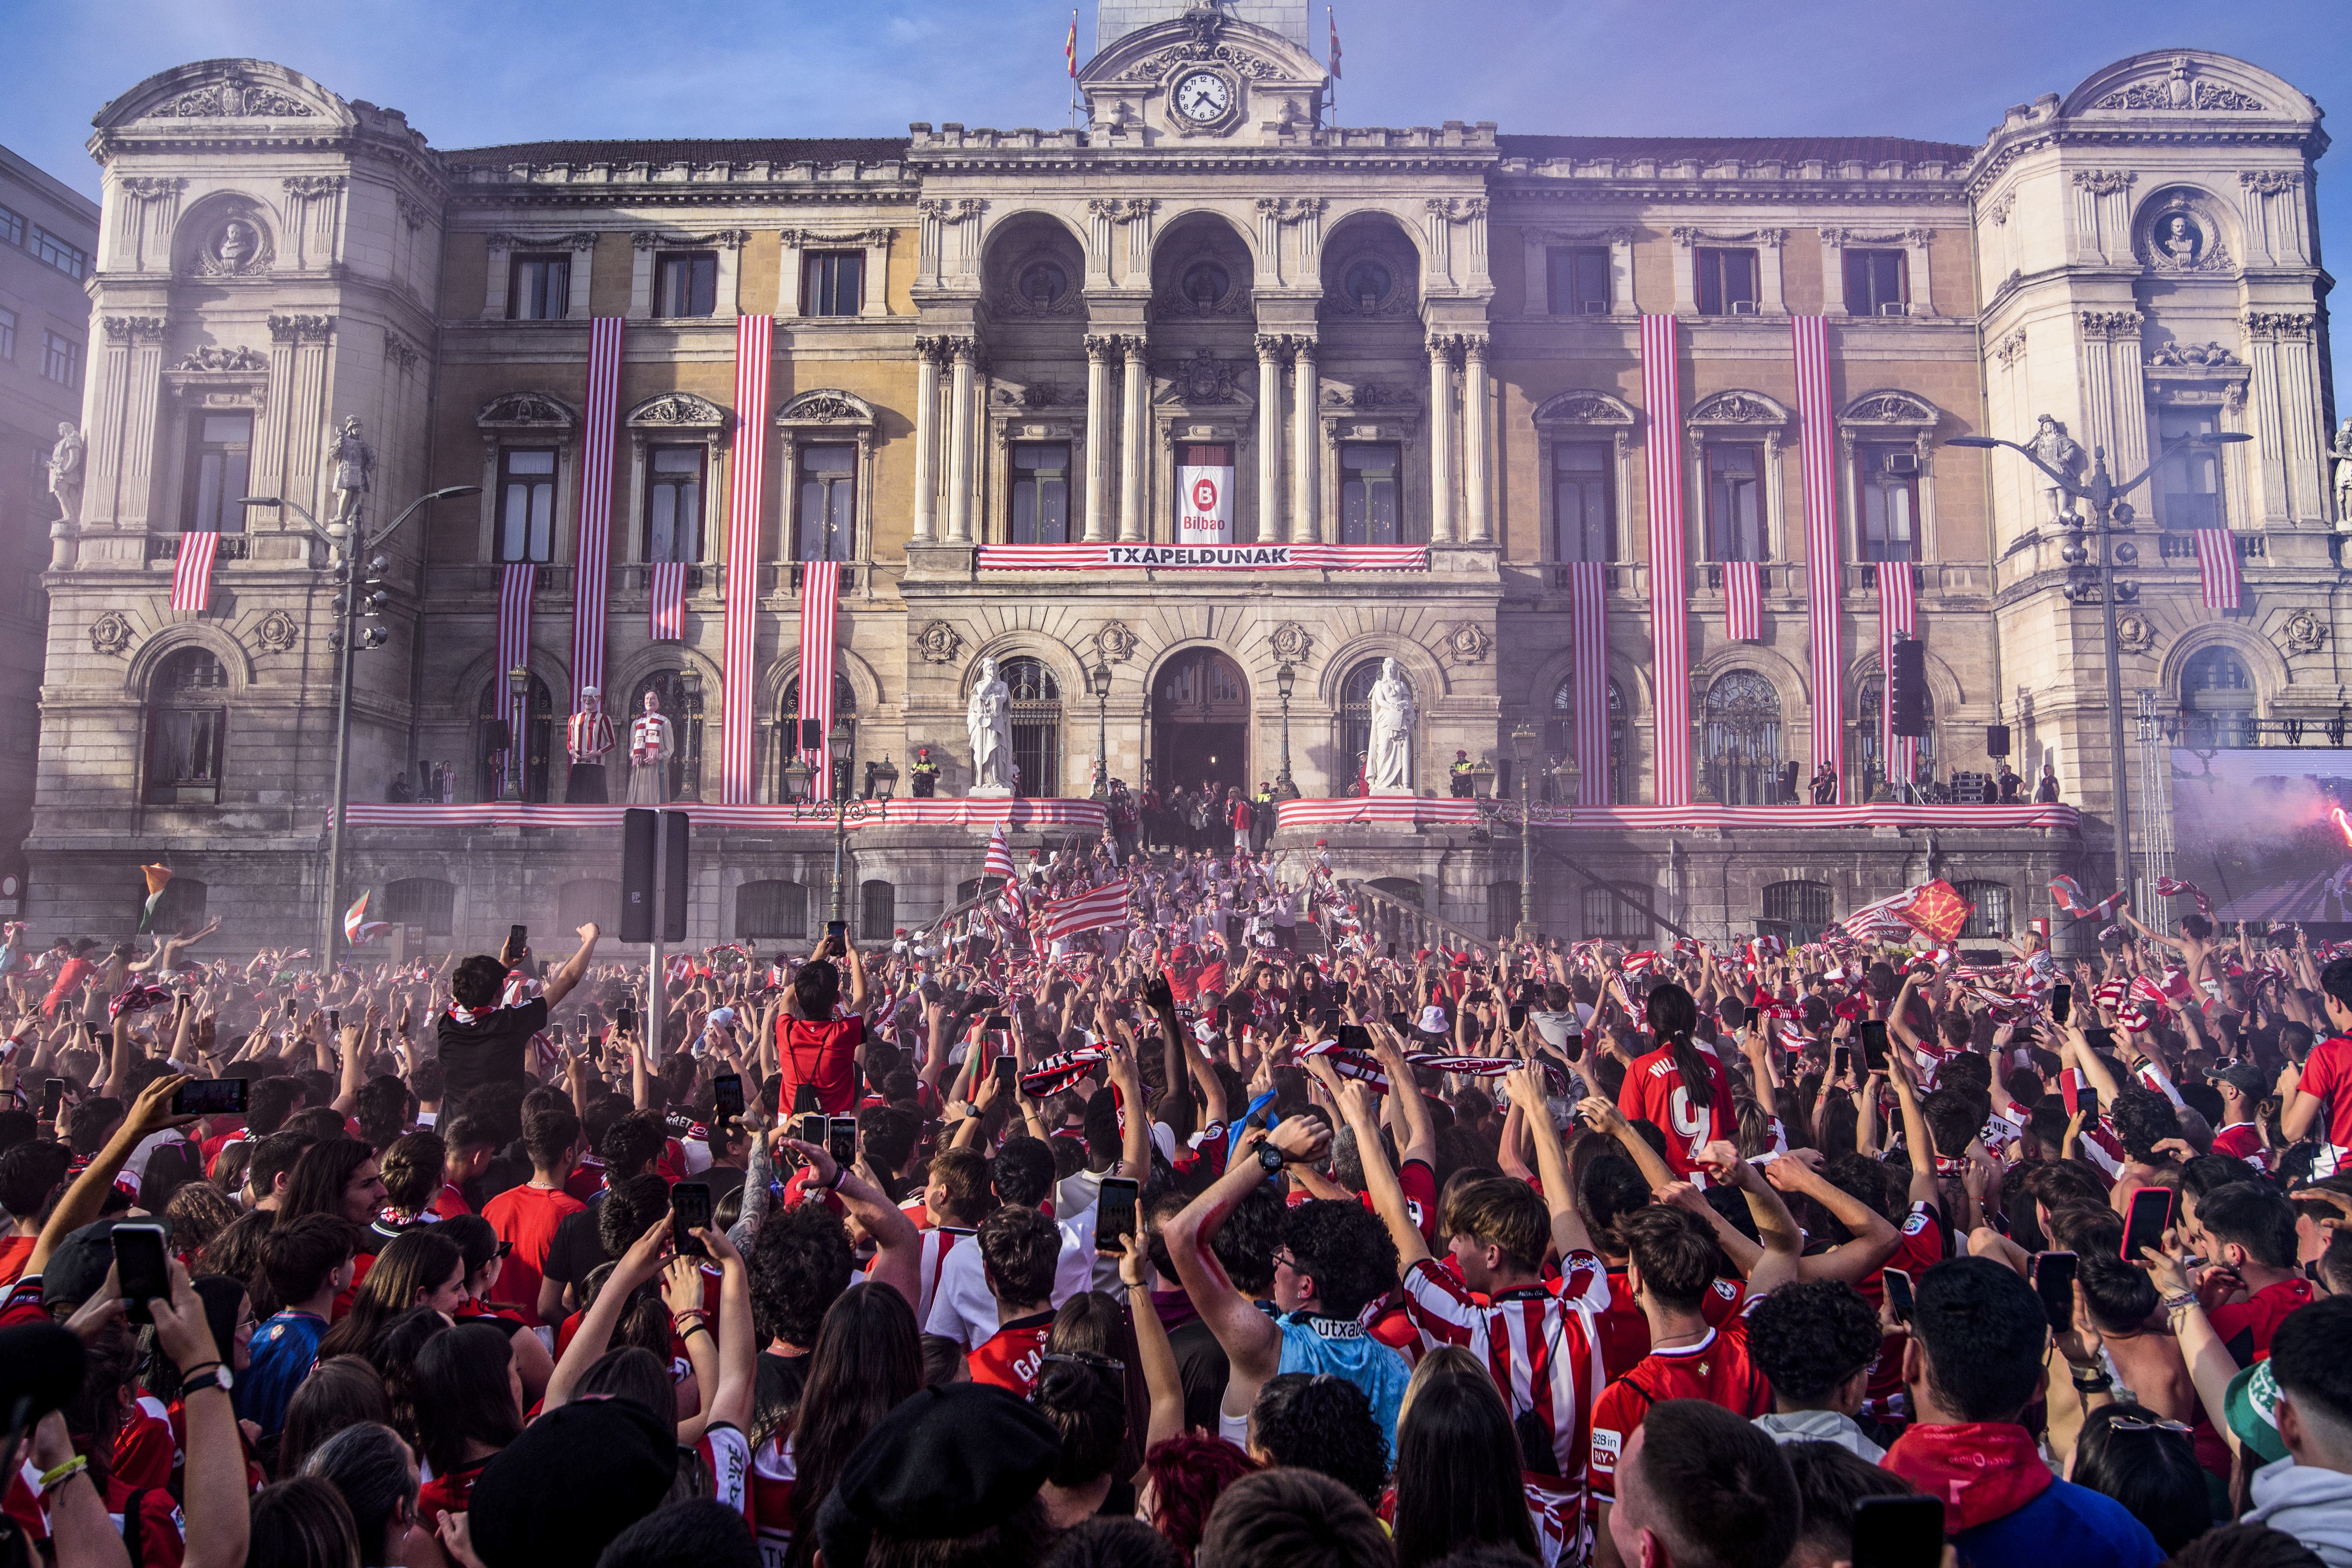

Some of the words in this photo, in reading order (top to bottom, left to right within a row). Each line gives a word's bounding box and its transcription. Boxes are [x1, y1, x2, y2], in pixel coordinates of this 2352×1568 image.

[1199, 487, 1212, 504] B
[1184, 516, 1225, 530] Bilbao
[1110, 548, 1288, 564] TXAPELDUNAK
[1670, 1086, 1710, 1159] 9
[1318, 1320, 1364, 1337] utxab
[1593, 1432, 1606, 1445] B2B
[1608, 1435, 1616, 1447] in
[1595, 1449, 1608, 1463] PAY
